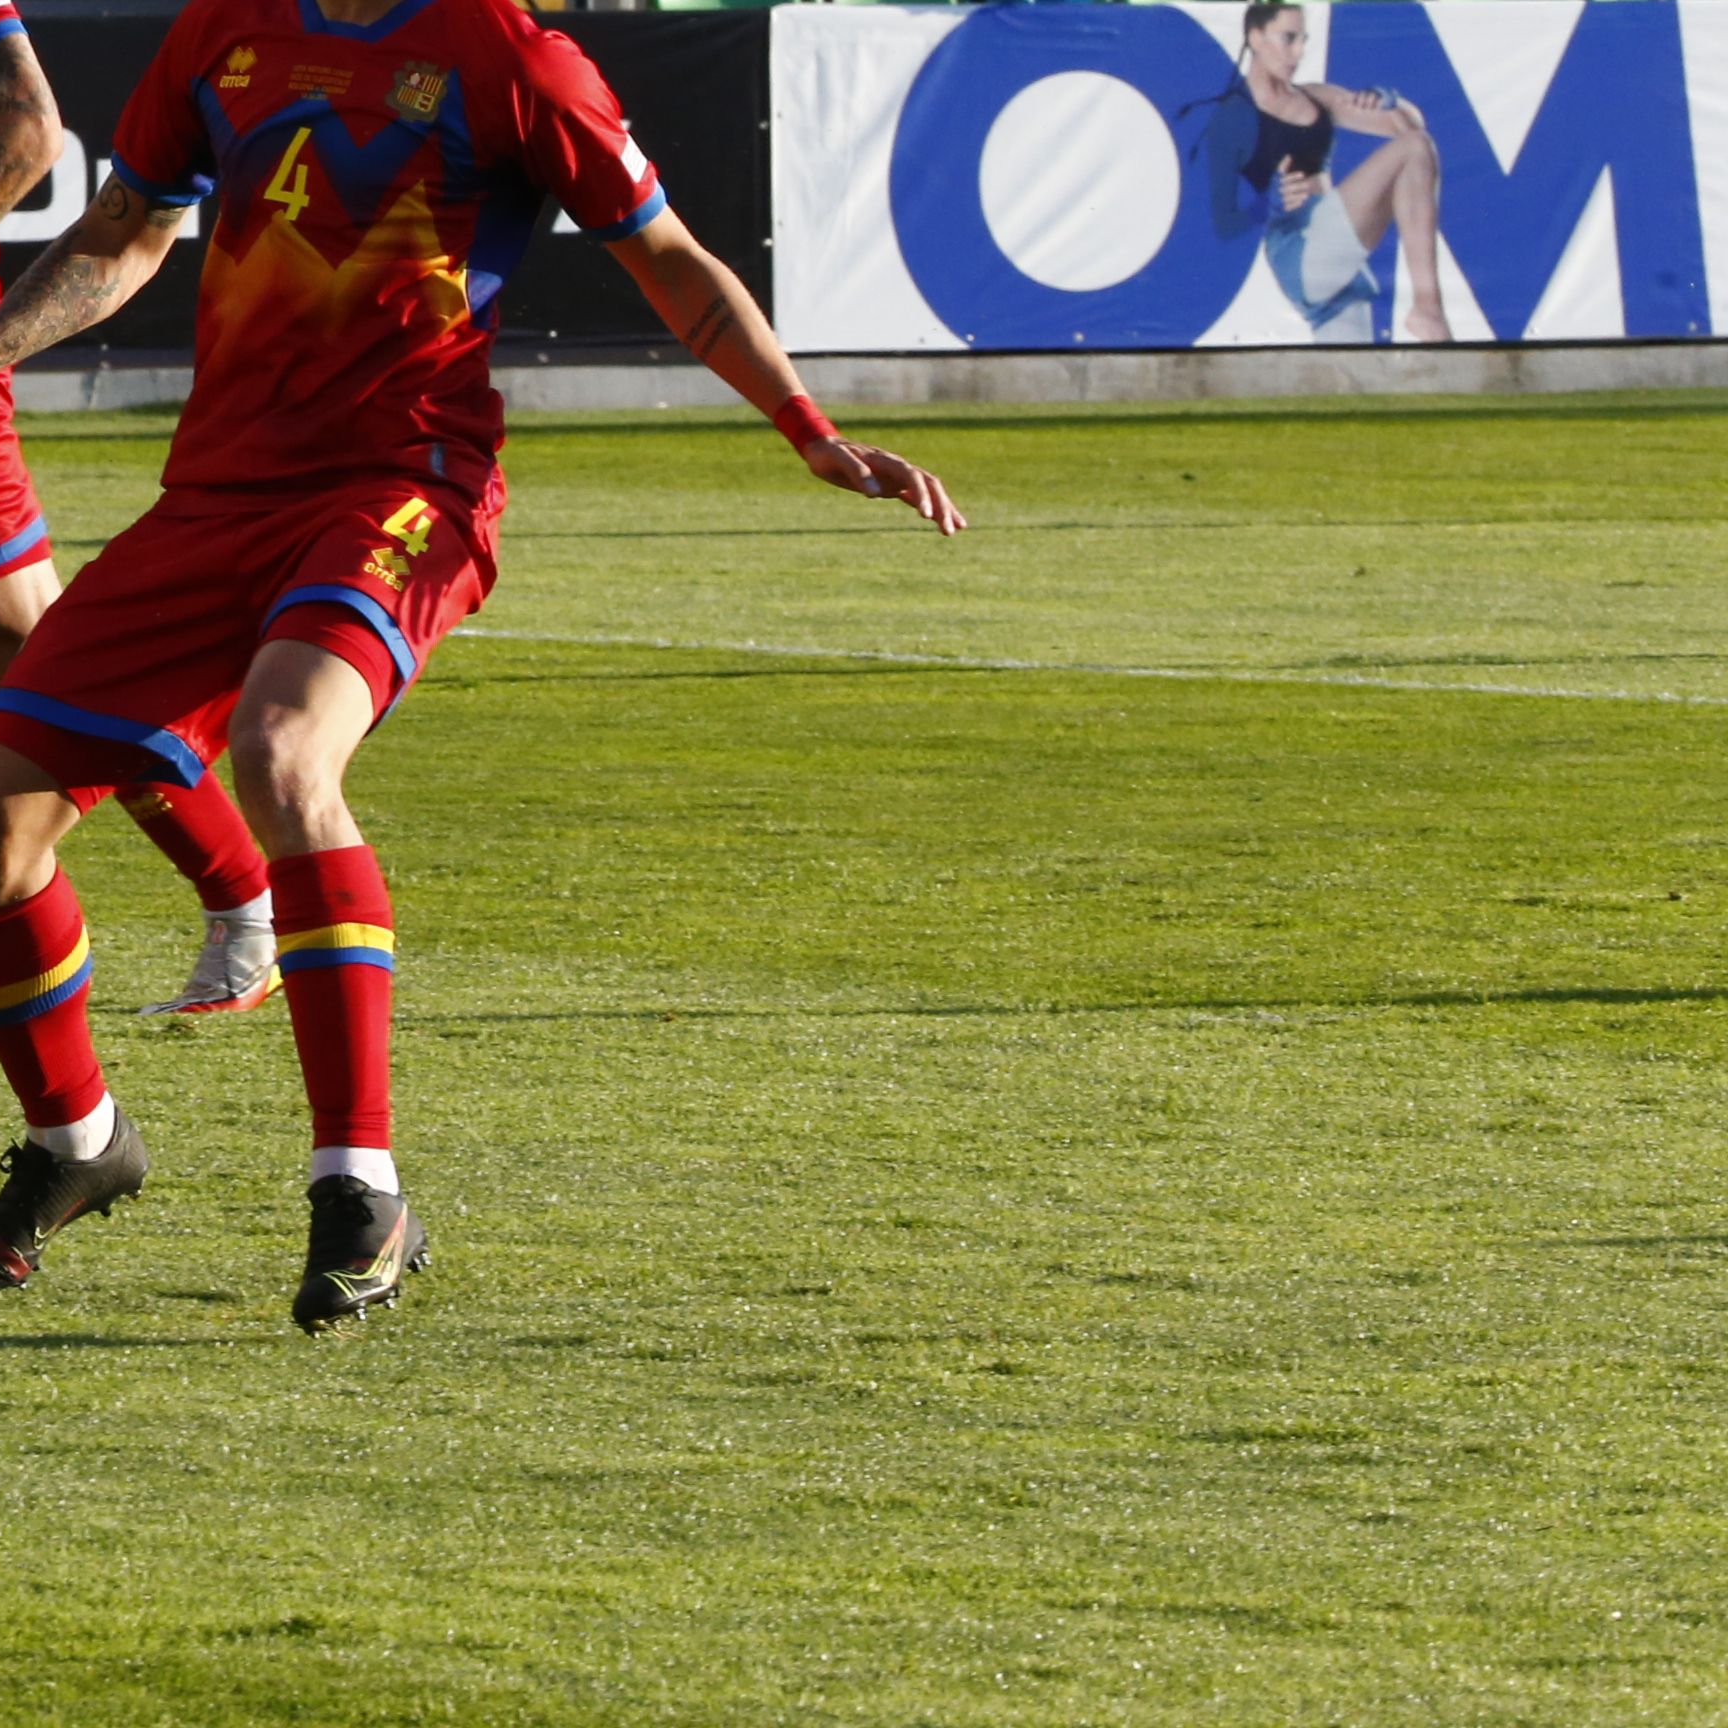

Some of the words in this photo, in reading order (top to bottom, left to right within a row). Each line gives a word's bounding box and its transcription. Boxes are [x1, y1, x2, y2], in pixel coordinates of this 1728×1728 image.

[263, 126, 312, 221] 4
[889, 2, 1710, 349] OM
[382, 496, 432, 557] 4
